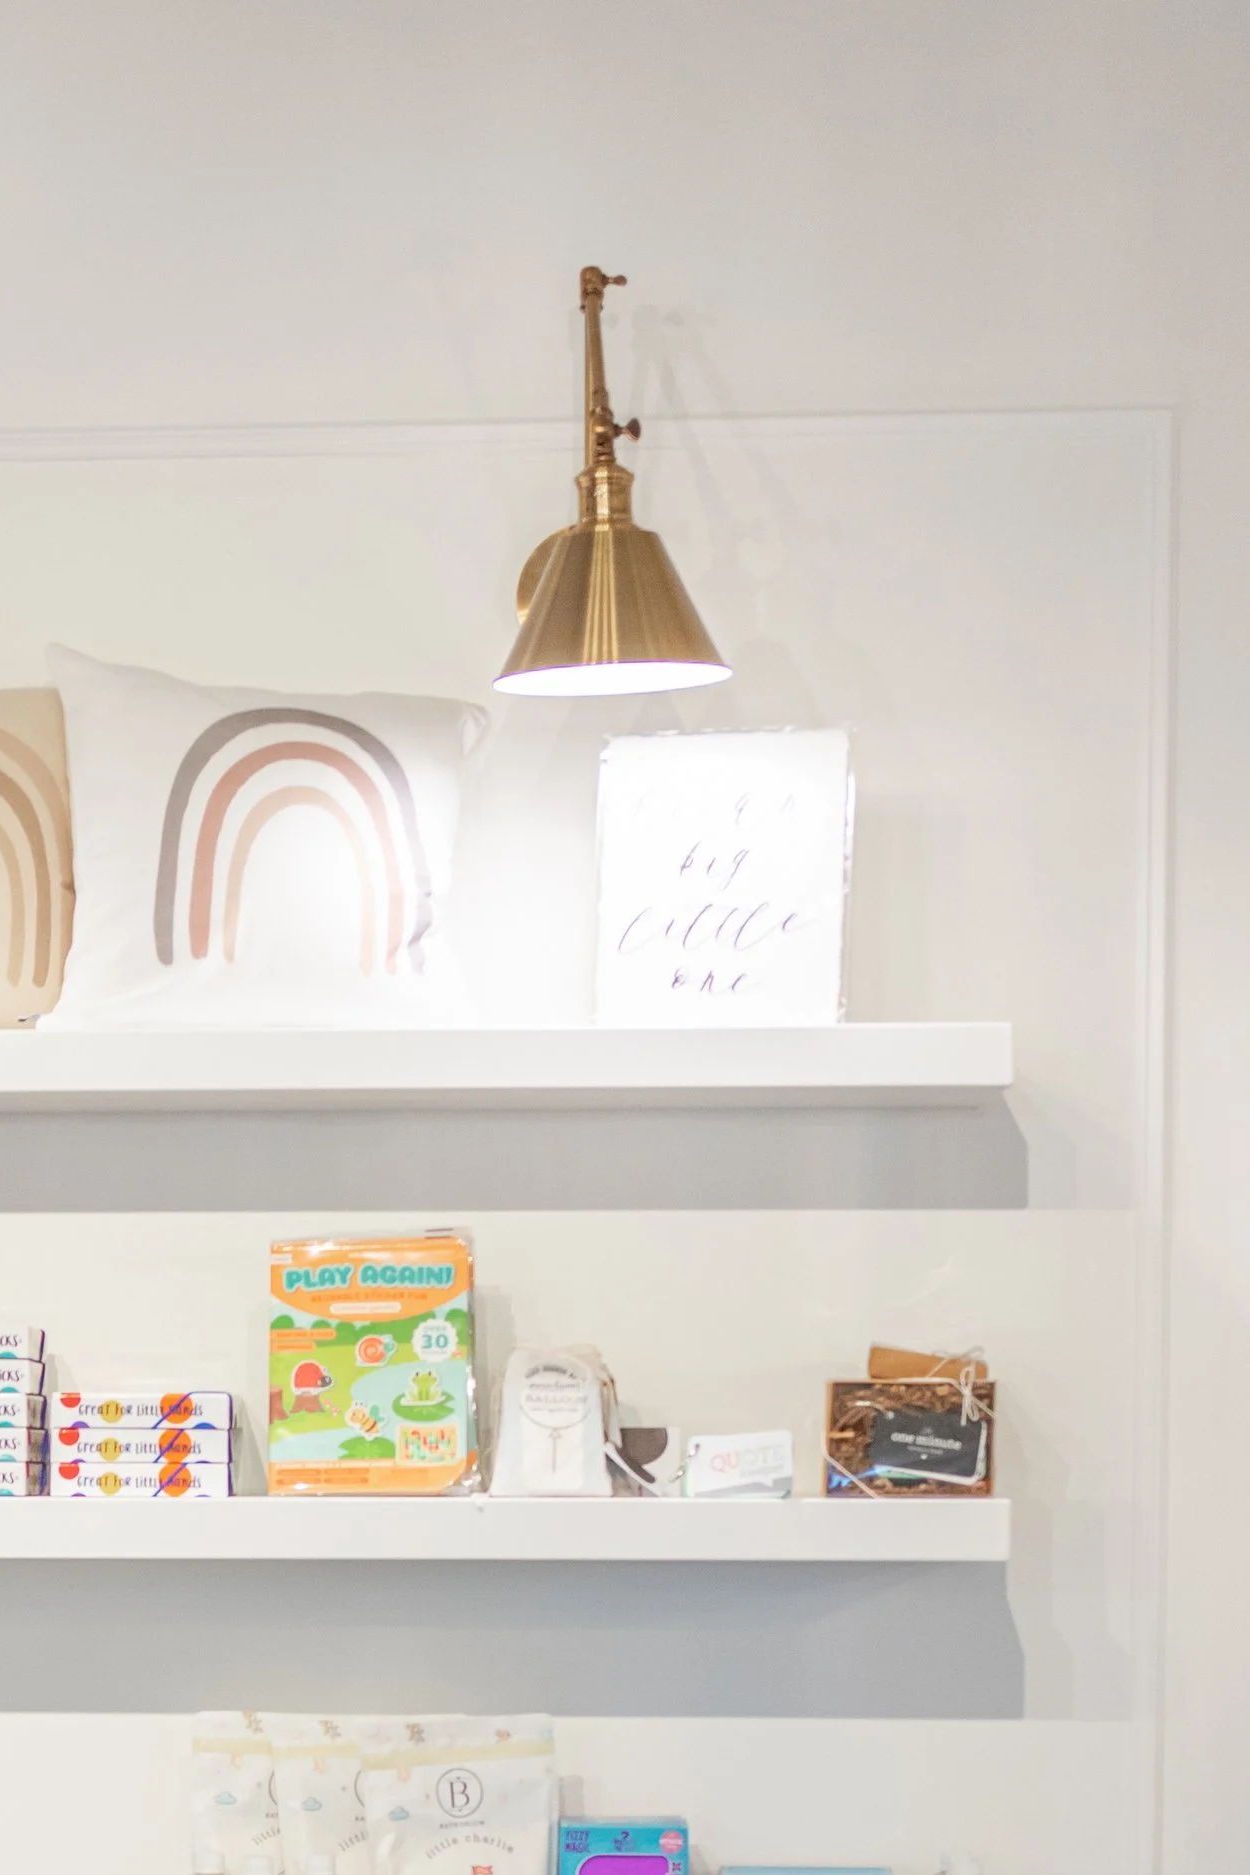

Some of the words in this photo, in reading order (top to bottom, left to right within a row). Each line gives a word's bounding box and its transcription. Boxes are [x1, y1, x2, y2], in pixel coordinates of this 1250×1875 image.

[680, 840, 749, 891] big
[618, 902, 816, 954] little
[672, 967, 761, 994] one
[284, 1265, 353, 1291] PLAY
[359, 1264, 455, 1287] AGAIN!
[421, 1334, 449, 1349] 30
[425, 1837, 458, 1859] little
[464, 1833, 514, 1854] charlie
